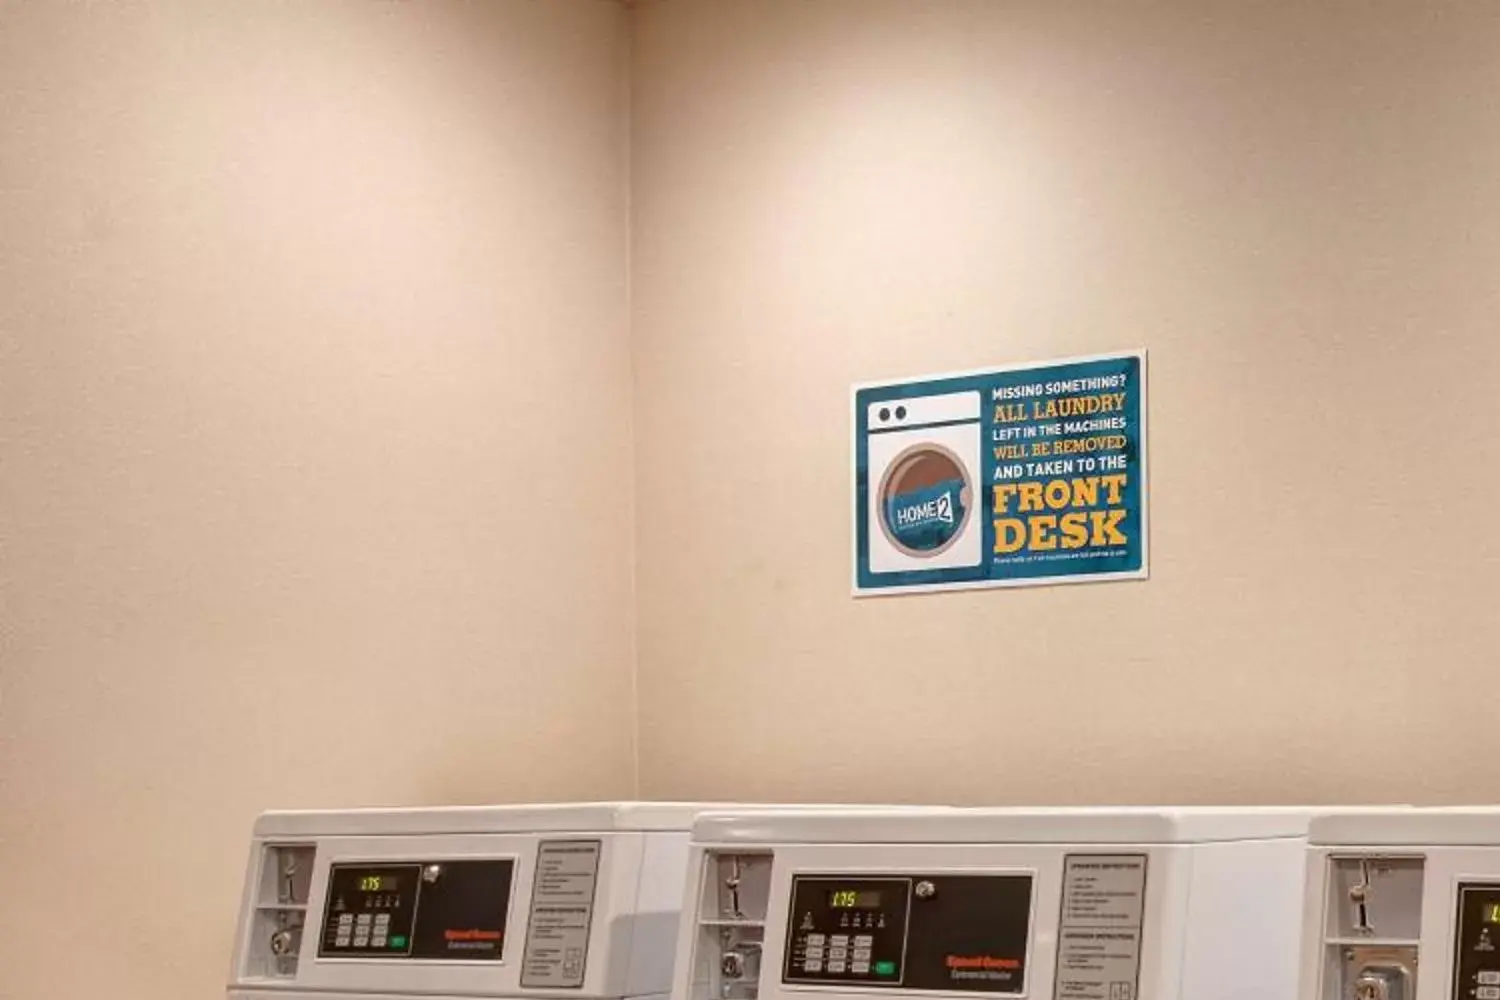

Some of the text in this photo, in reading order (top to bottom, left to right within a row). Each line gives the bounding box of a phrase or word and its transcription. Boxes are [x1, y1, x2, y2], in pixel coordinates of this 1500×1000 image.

[992, 374, 1126, 400] MISSING SOMETHING?
[993, 393, 1125, 424] ALL LAUNDRY
[993, 417, 1126, 441] LEFT IN THE MACHINES
[993, 435, 1126, 460] WILL BE REMOVED
[993, 455, 1127, 479] AND TAKEN TO THE
[992, 474, 1127, 513] FRONT
[993, 510, 1127, 554] DESK
